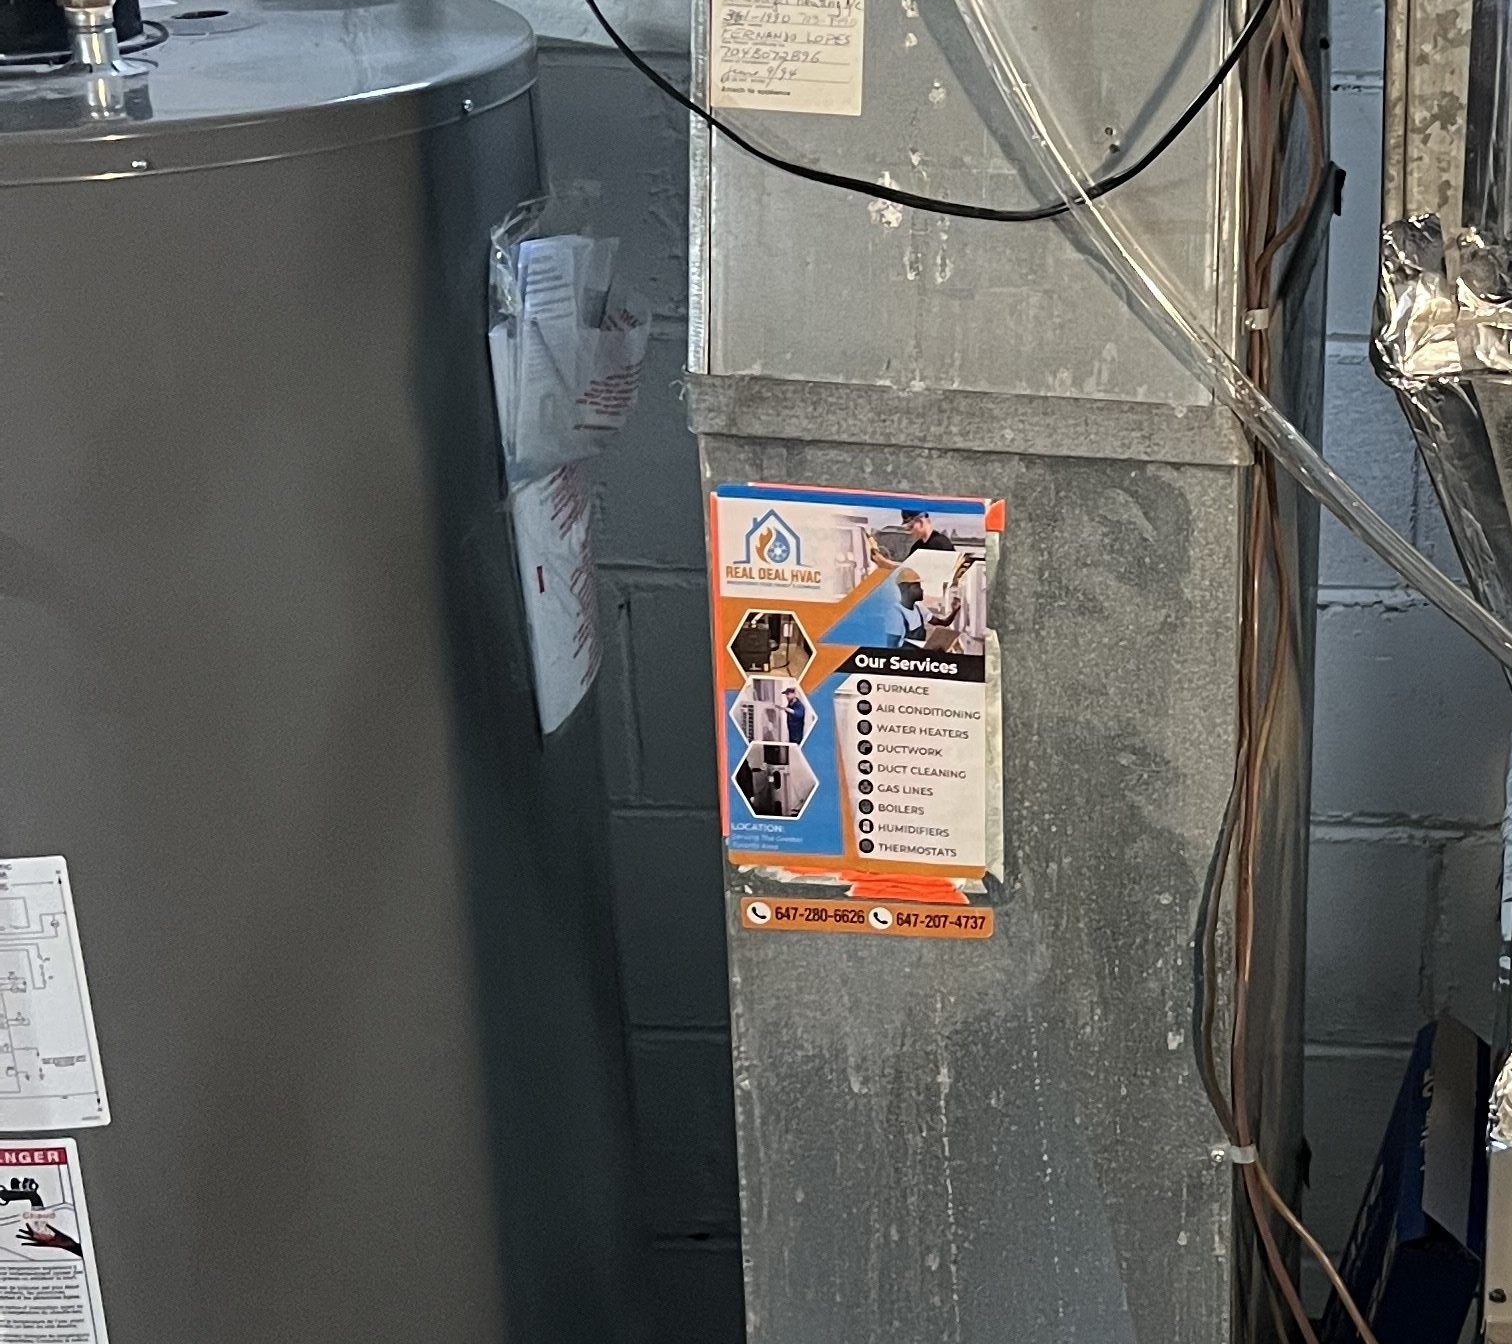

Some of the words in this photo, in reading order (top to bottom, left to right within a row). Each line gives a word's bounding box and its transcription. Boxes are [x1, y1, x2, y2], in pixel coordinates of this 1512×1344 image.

[725, 565, 755, 580] REAL
[758, 567, 788, 581] DEAL
[791, 569, 822, 584] HVAC
[854, 654, 887, 668] Our
[889, 656, 959, 675] Services
[876, 683, 930, 696] FURNACE
[875, 703, 896, 714] AIR
[897, 705, 982, 720] CONDITIONING
[876, 723, 917, 735] WATER
[919, 727, 970, 740] HEATERS
[876, 744, 944, 757] DUCTWORK
[877, 763, 908, 775] DUCT
[909, 766, 967, 780] CLEANING
[877, 783, 900, 794] GAS
[902, 785, 934, 797] LINES
[878, 803, 925, 816] BOILERS
[878, 823, 950, 838] HUMIDIFIERS
[878, 842, 958, 858] THERMOSTATS
[774, 906, 865, 924] 647-280-6626
[896, 912, 987, 930] 647-207-4737
[0, 1150, 60, 1164] NGER
